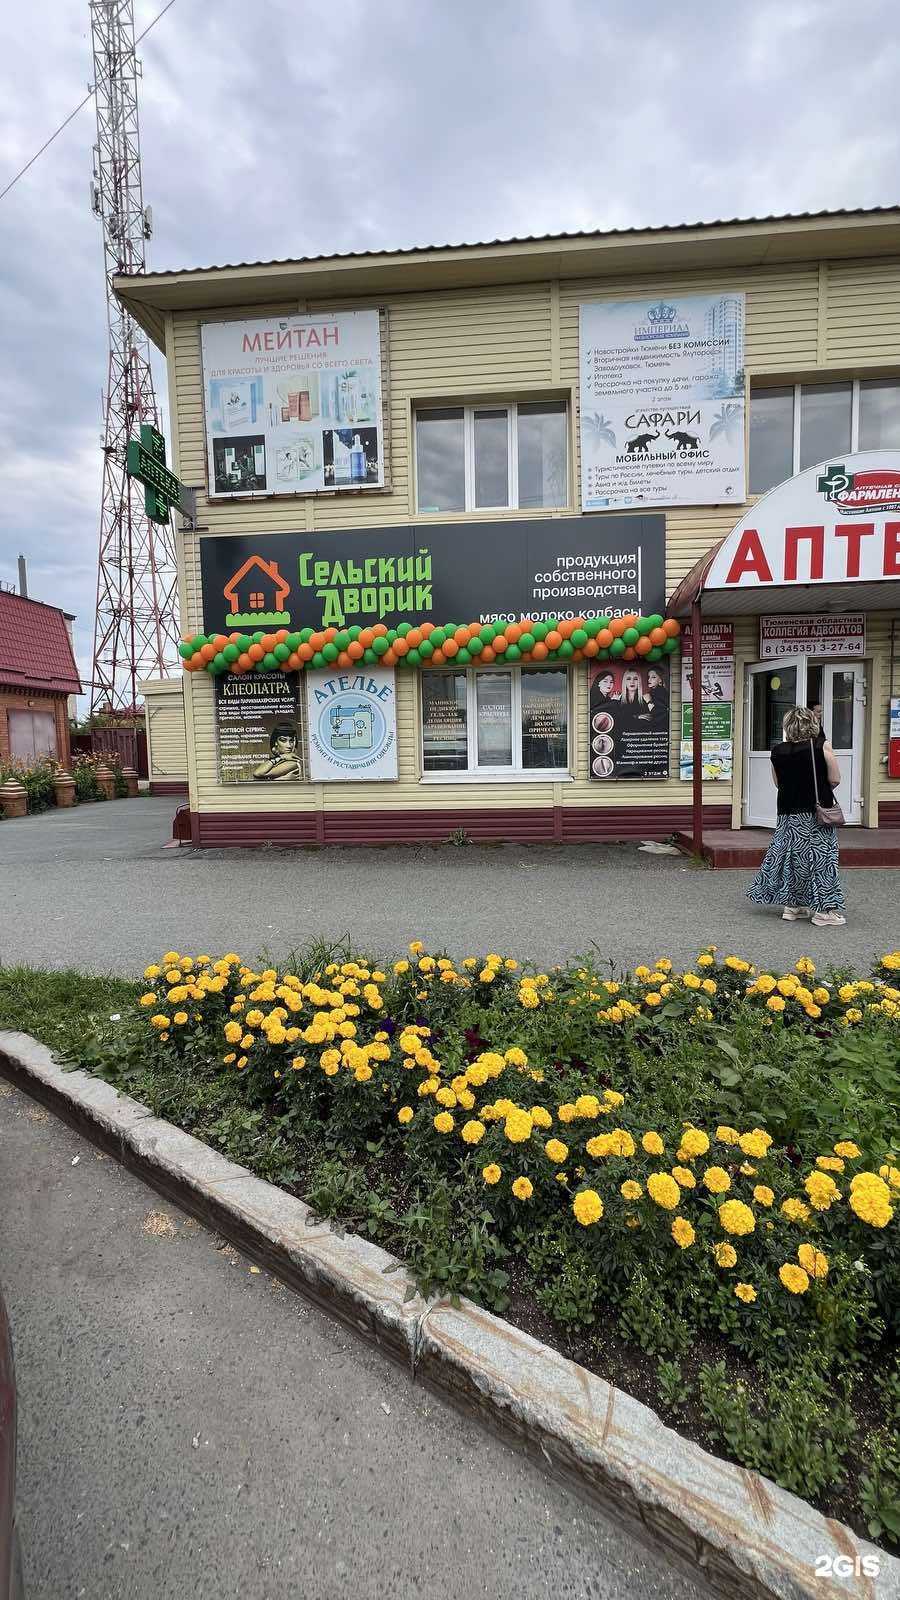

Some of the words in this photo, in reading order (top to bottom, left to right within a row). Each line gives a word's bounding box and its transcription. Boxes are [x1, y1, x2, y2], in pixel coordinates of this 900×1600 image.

[668, 342, 682, 350] БЕЗ
[684, 339, 730, 349] КОМИССИИ
[625, 410, 701, 429] САФАРИ
[616, 451, 677, 463] МОБИЛЬНЫЙ
[680, 450, 710, 459] ОФИС
[299, 548, 432, 587] Сельский
[556, 553, 636, 570] продукция
[534, 569, 637, 583] собственного
[532, 583, 637, 600] производства
[315, 584, 433, 627] Дворик
[479, 613, 516, 624] мясо
[520, 610, 575, 622] молоко
[578, 606, 642, 619] колбасы
[764, 626, 809, 637] КОЛЛЕГИЯ
[810, 624, 863, 636] АДВОКАТОВ
[775, 644, 817, 654] (34535)
[820, 642, 861, 652] 3-27-64
[253, 672, 286, 680] КРАСОТЫ
[223, 682, 290, 696] КЛЕОПАТРА
[313, 675, 393, 705] АТЕЛЬЕ
